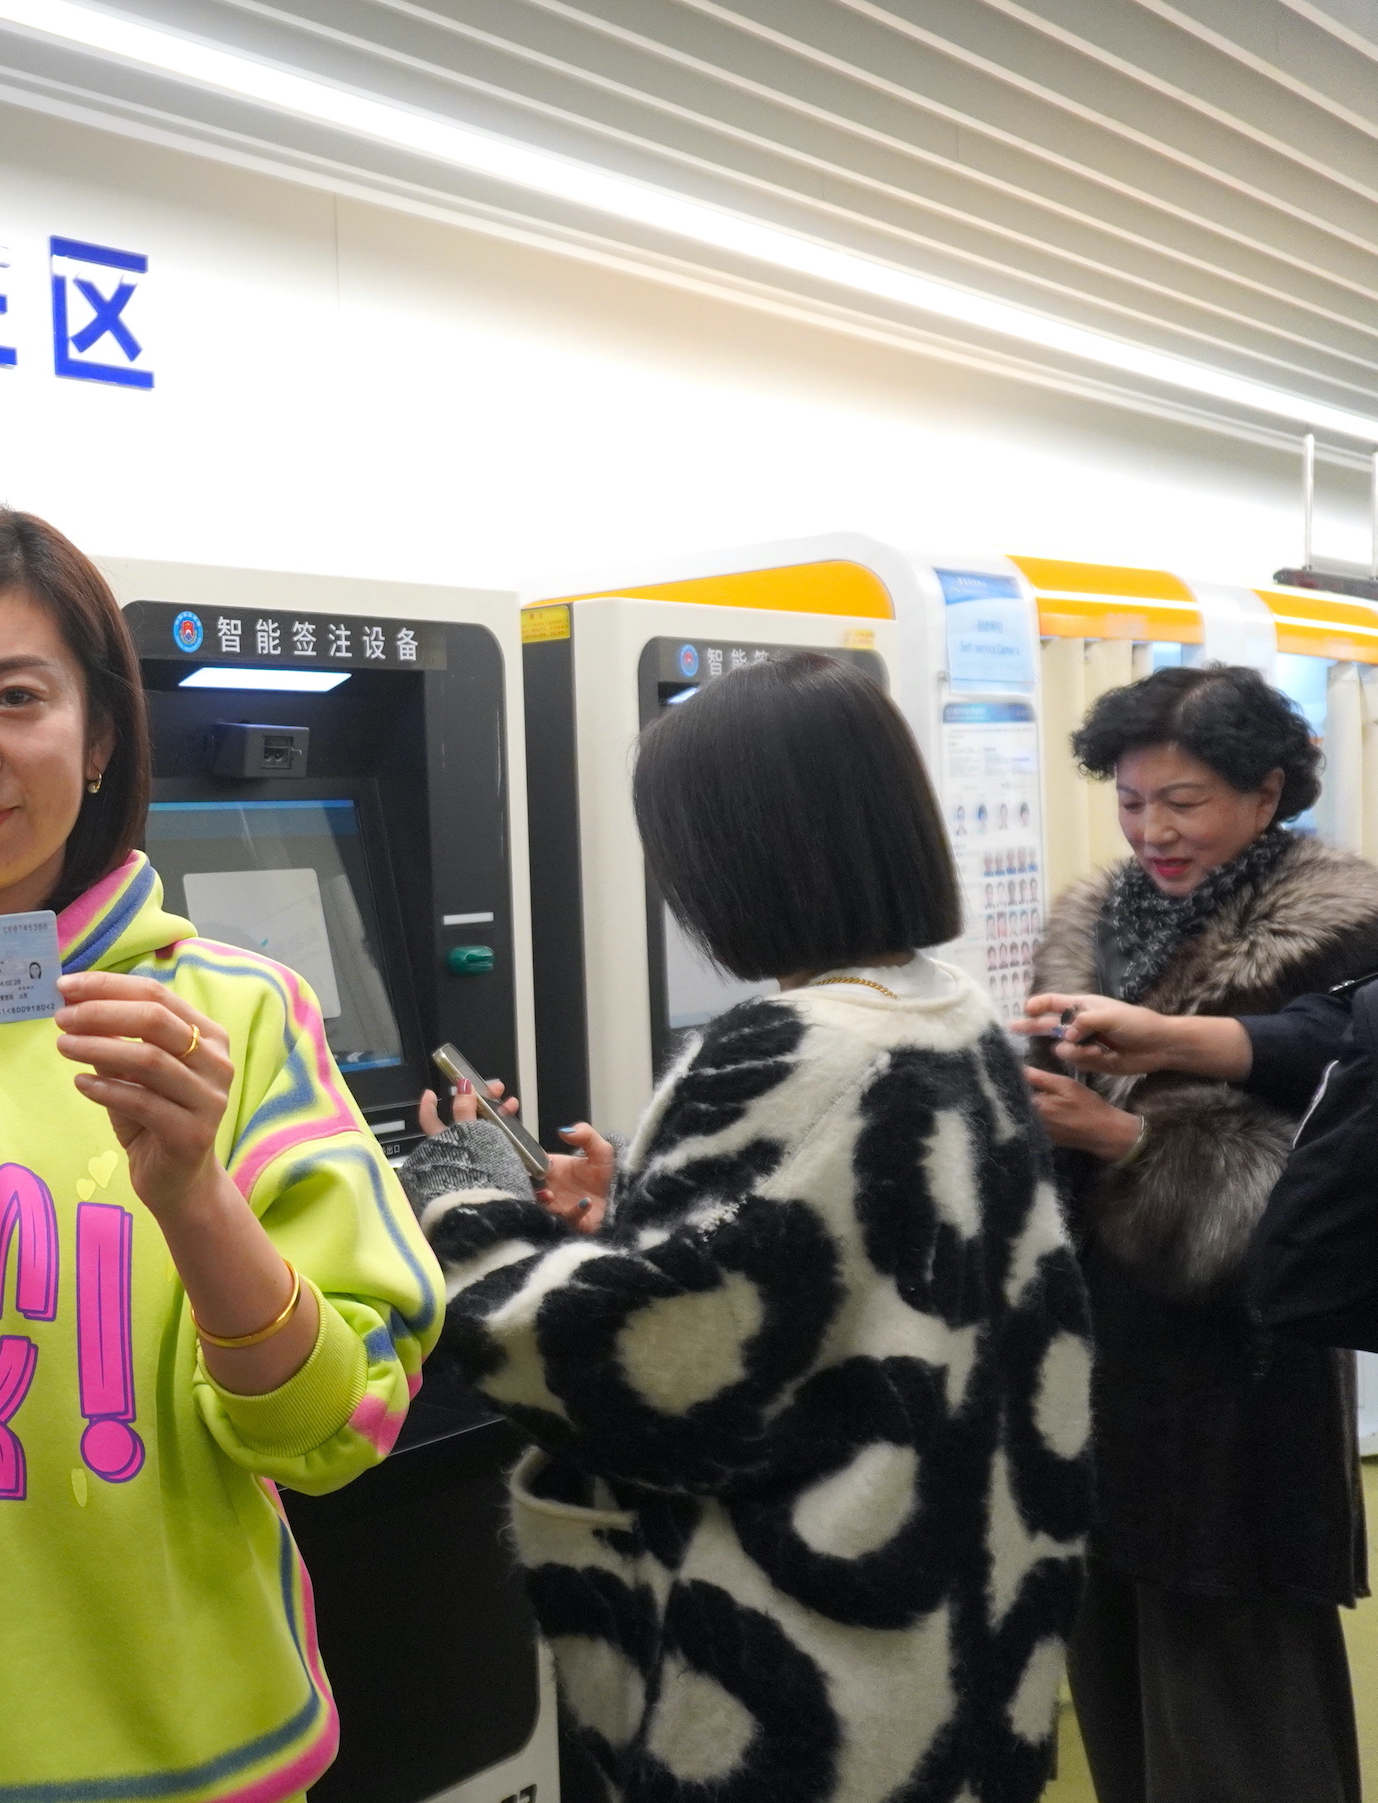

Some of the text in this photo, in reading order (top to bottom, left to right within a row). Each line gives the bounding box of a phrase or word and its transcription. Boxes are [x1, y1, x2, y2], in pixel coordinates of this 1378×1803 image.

[217, 616, 418, 661] 智能签注设备
[383, 1144, 400, 1155] 出口
